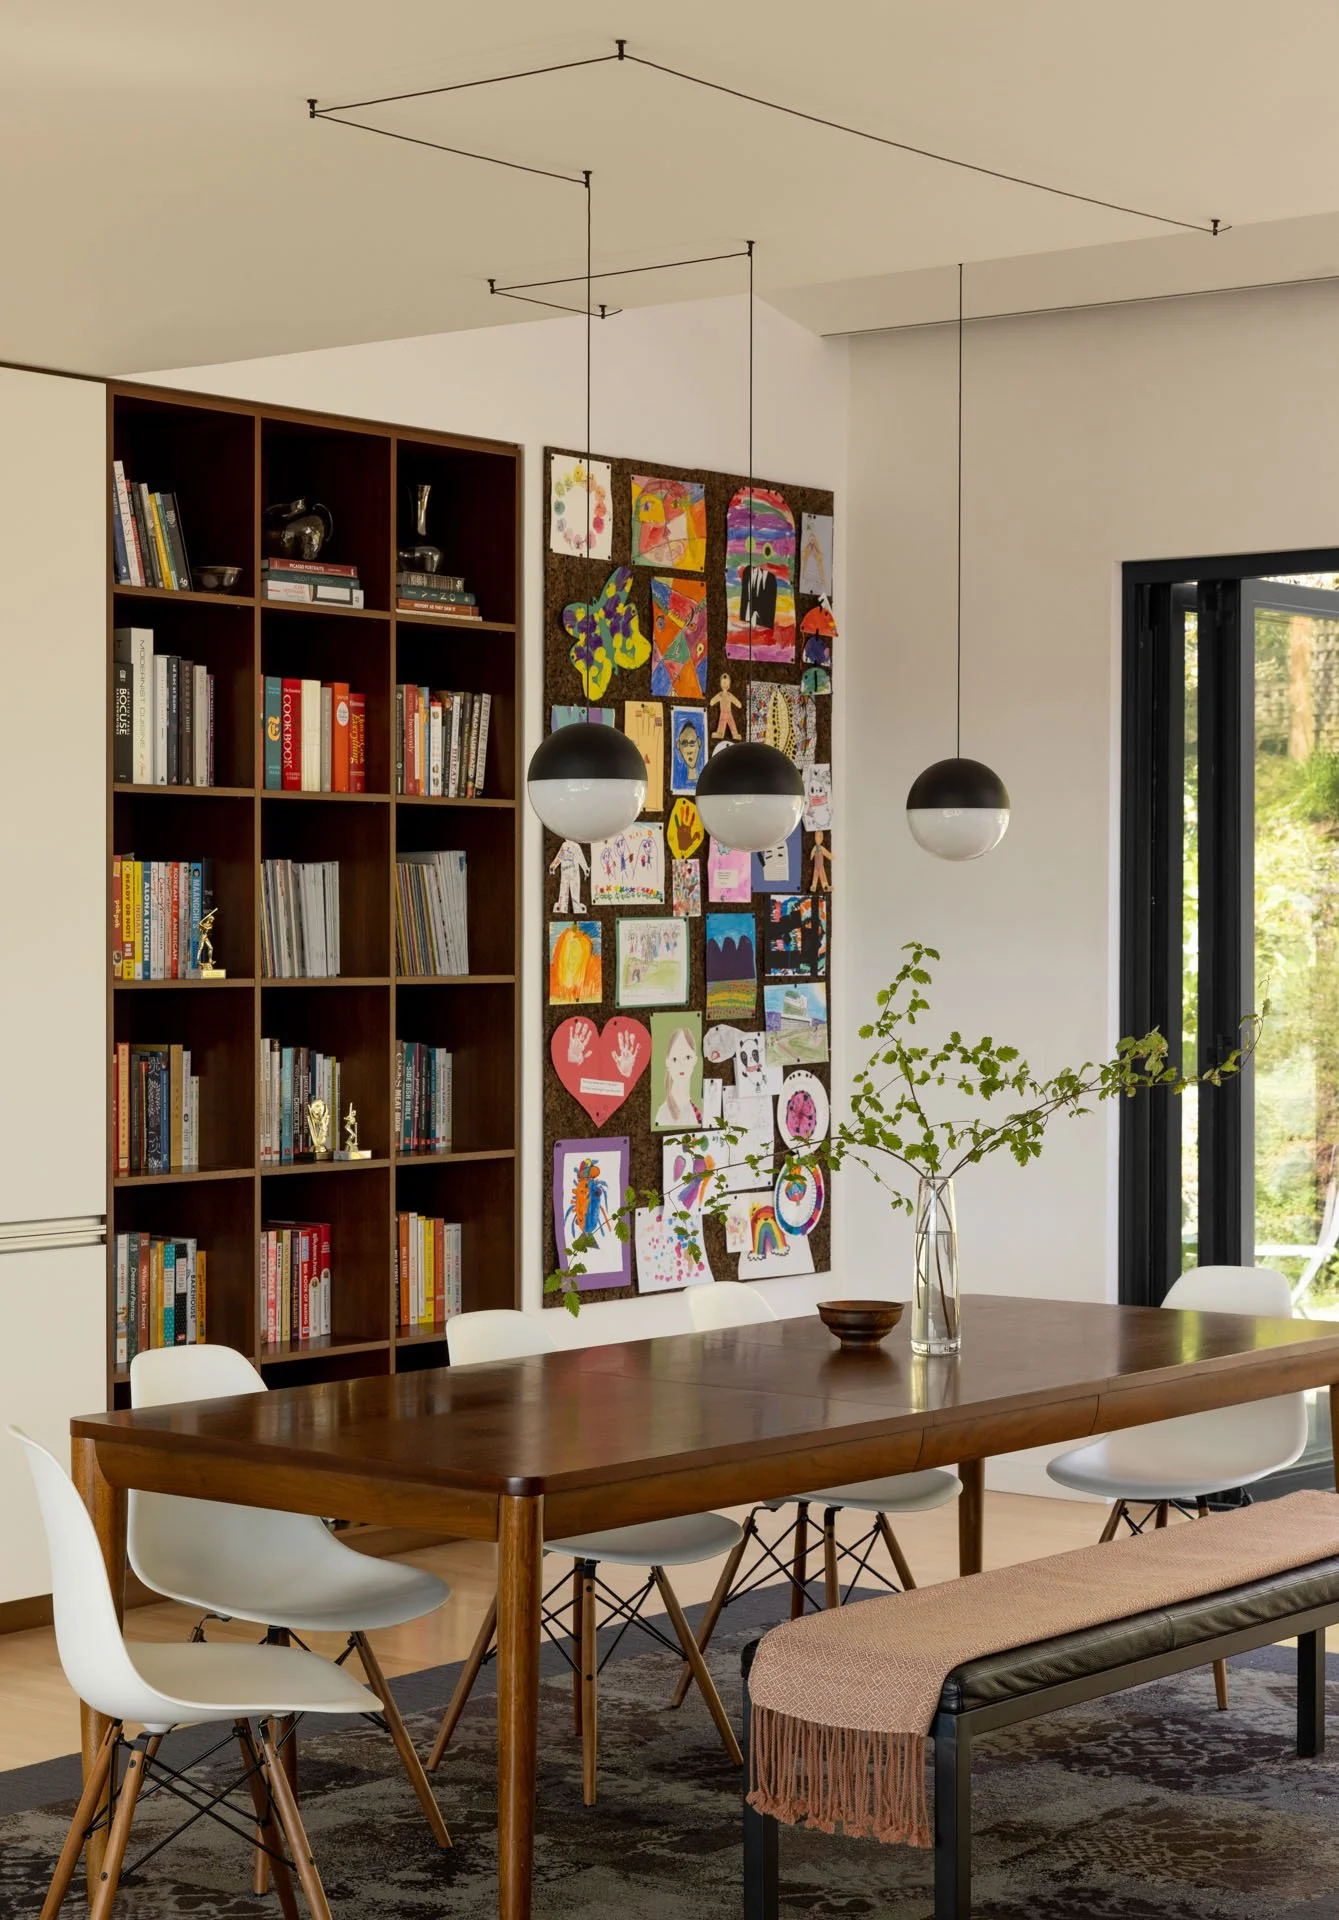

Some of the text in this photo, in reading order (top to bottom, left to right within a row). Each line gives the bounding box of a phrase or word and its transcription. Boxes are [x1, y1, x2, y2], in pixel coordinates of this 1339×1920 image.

[116, 472, 133, 547] MATISSE
[119, 688, 127, 735] BOCUSE
[283, 694, 293, 768] COOKBOOK
[350, 713, 360, 765] Everything
[468, 702, 480, 778] BREAD ILLUSTRATED
[476, 695, 490, 787] TARTINE BREAD
[125, 903, 131, 916] OR
[192, 879, 201, 929] MAANGCHI'S
